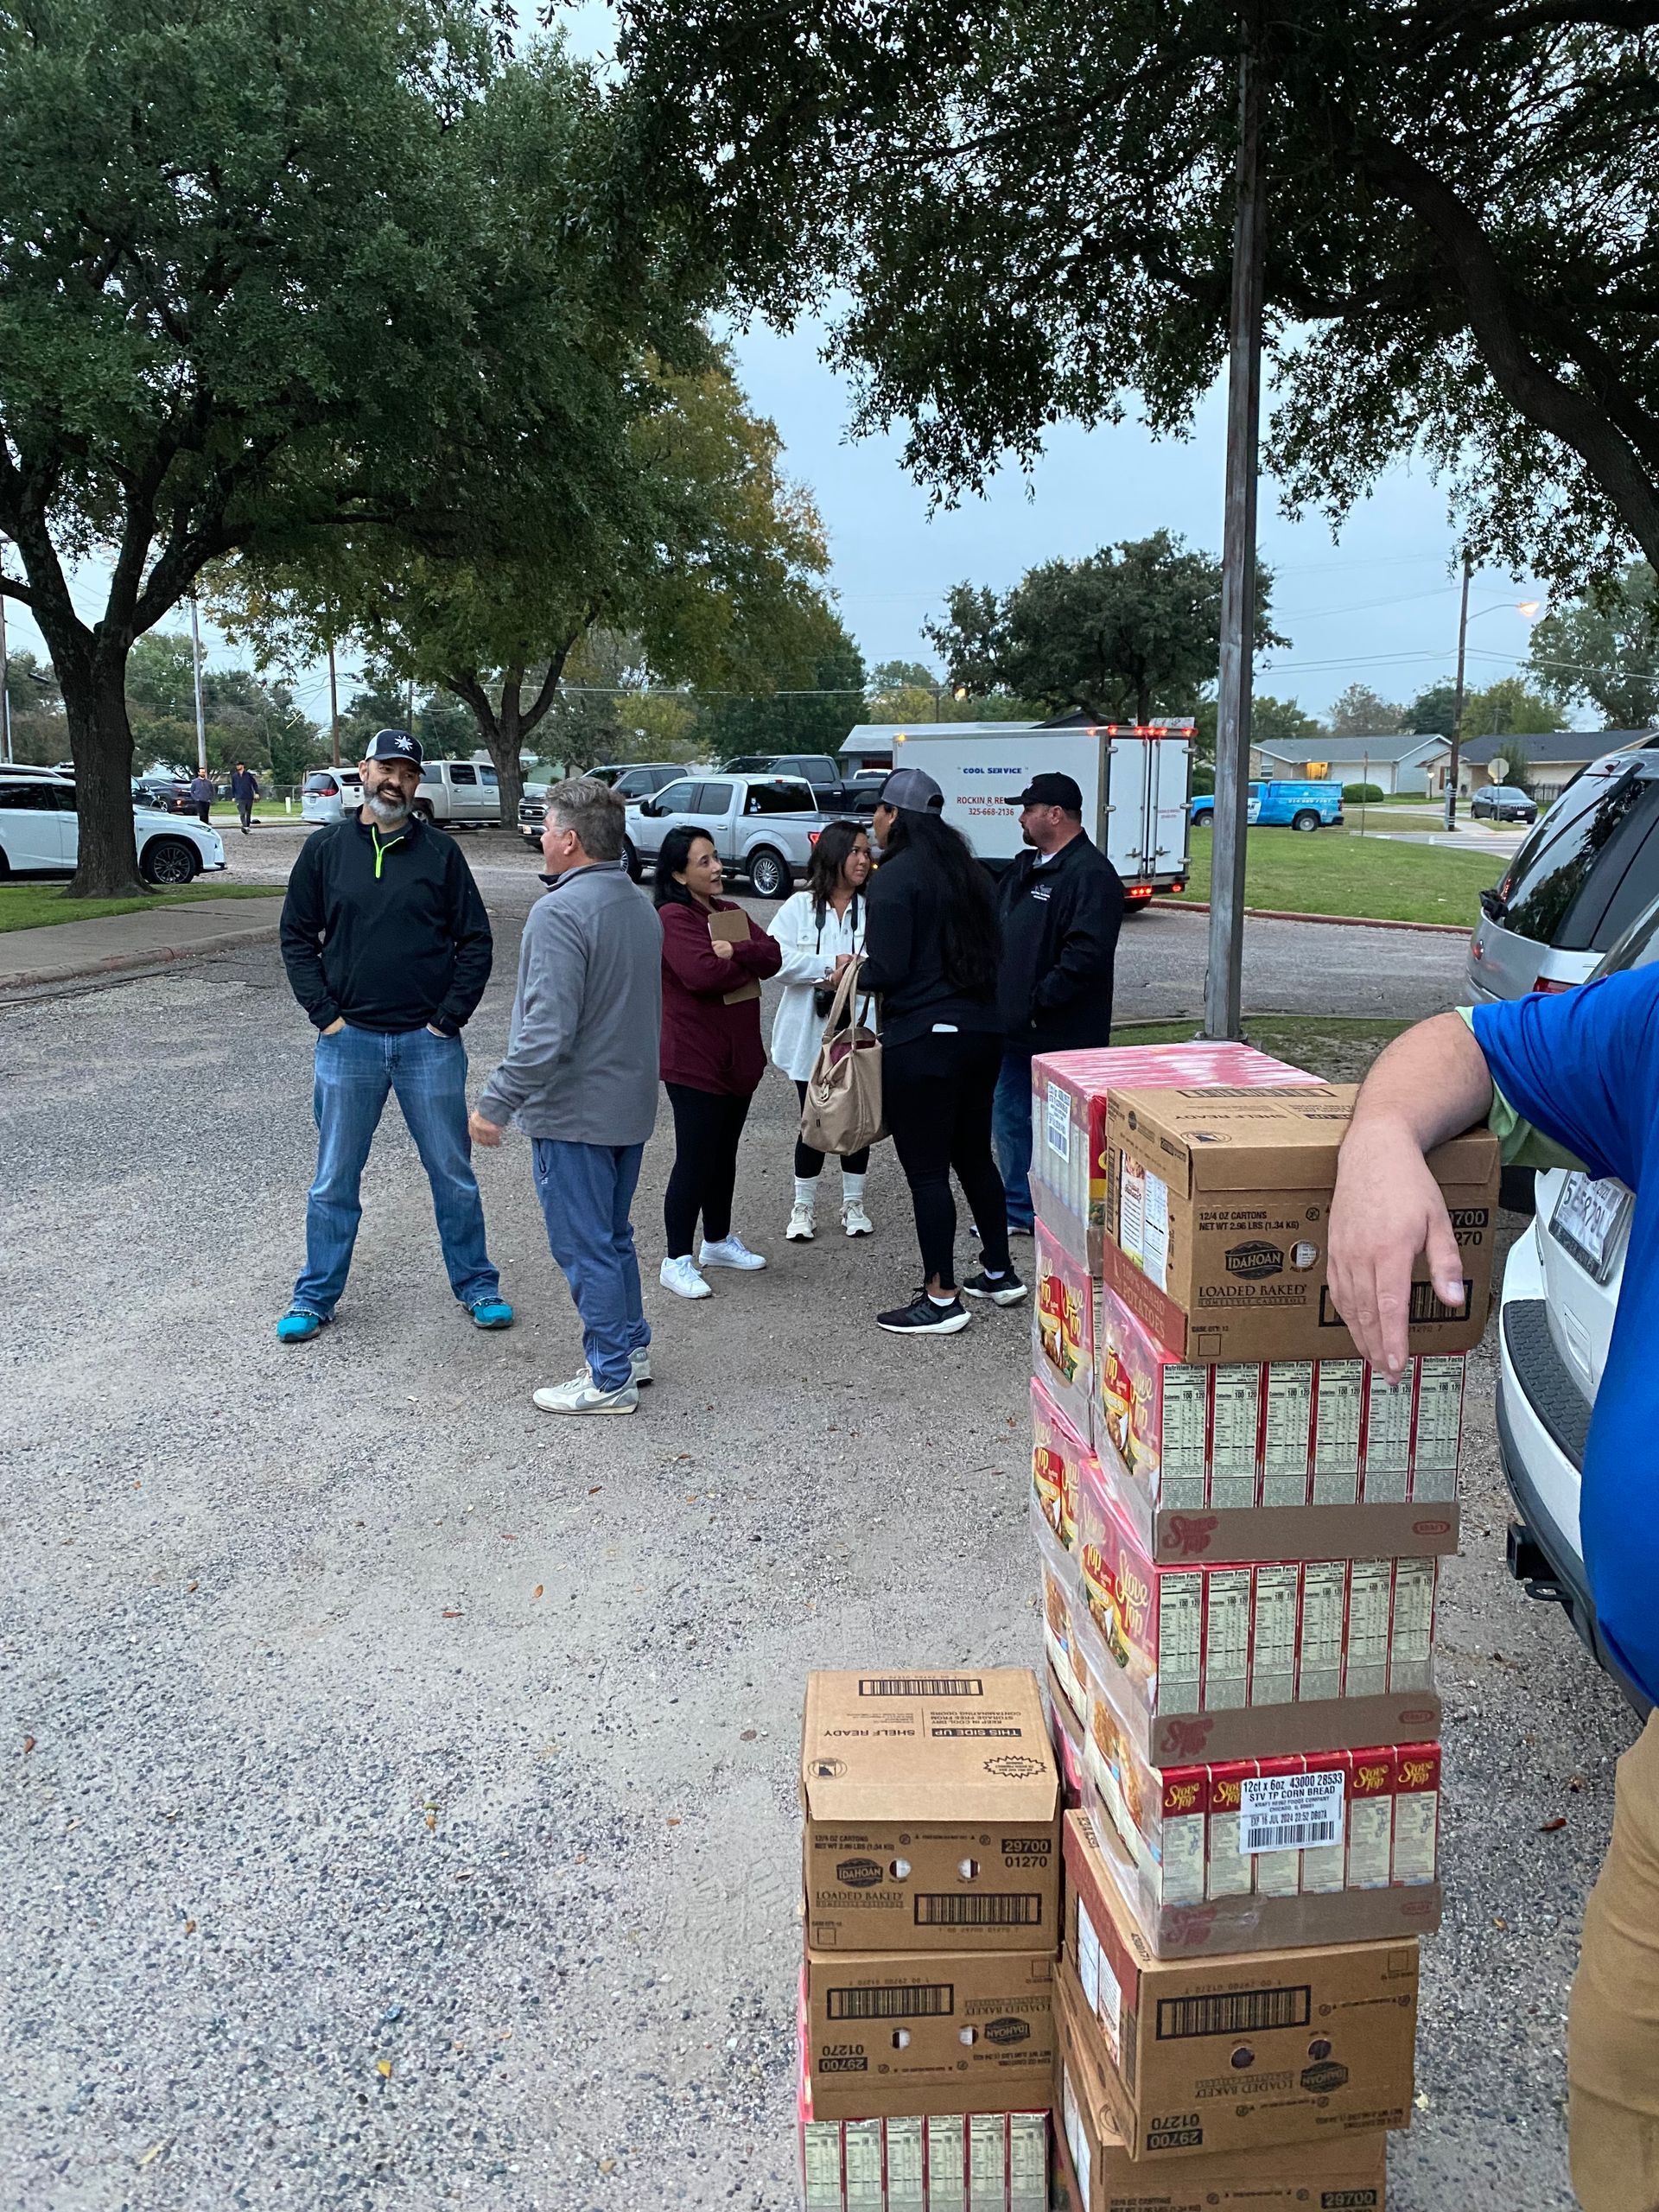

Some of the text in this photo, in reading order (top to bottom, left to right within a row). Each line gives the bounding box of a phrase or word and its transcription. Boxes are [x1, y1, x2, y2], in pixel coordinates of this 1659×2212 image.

[1199, 1211, 1268, 1220] 12/4 OZ CARTONS
[1455, 1231, 1483, 1247] 270
[1227, 1254, 1281, 1269] IDAHOAN
[1198, 1285, 1255, 1297] LOADED
[1115, 1549, 1149, 1608] Stove
[1123, 1599, 1143, 1637] Top
[1354, 1764, 1389, 1789] Stove
[1398, 1760, 1434, 1783] Stove
[1244, 1780, 1261, 1793] 12ct
[1270, 1779, 1285, 1790] 6oz
[1289, 1775, 1315, 1789] 43000
[1317, 1772, 1343, 1786] 28533
[1366, 1777, 1384, 1791] Top
[1411, 1772, 1429, 1788] Top
[1165, 1783, 1200, 1808] Stove
[1249, 1785, 1336, 1802] STV TP CORN BREAD
[1178, 1796, 1196, 1811] Top
[1250, 1815, 1260, 1827] EXP
[1269, 1814, 1279, 1825] JUL
[1004, 1840, 1049, 1853] 29700
[1005, 1856, 1048, 1868] 01270
[838, 1868, 881, 1879] IDAHOAN
[817, 1891, 862, 1900] LOADED
[1004, 2003, 1052, 2014] LOADED
[986, 2024, 1028, 2039] IDAHOAN
[822, 2044, 864, 2056] 01270
[821, 2059, 865, 2072] 29700
[1301, 2068, 1345, 2084] IDAHOAN
[1242, 2080, 1294, 2093] LOADED
[1151, 2113, 1200, 2131] 01270
[1150, 2131, 1200, 2149] 29700
[1325, 2192, 1374, 2206] 29700
